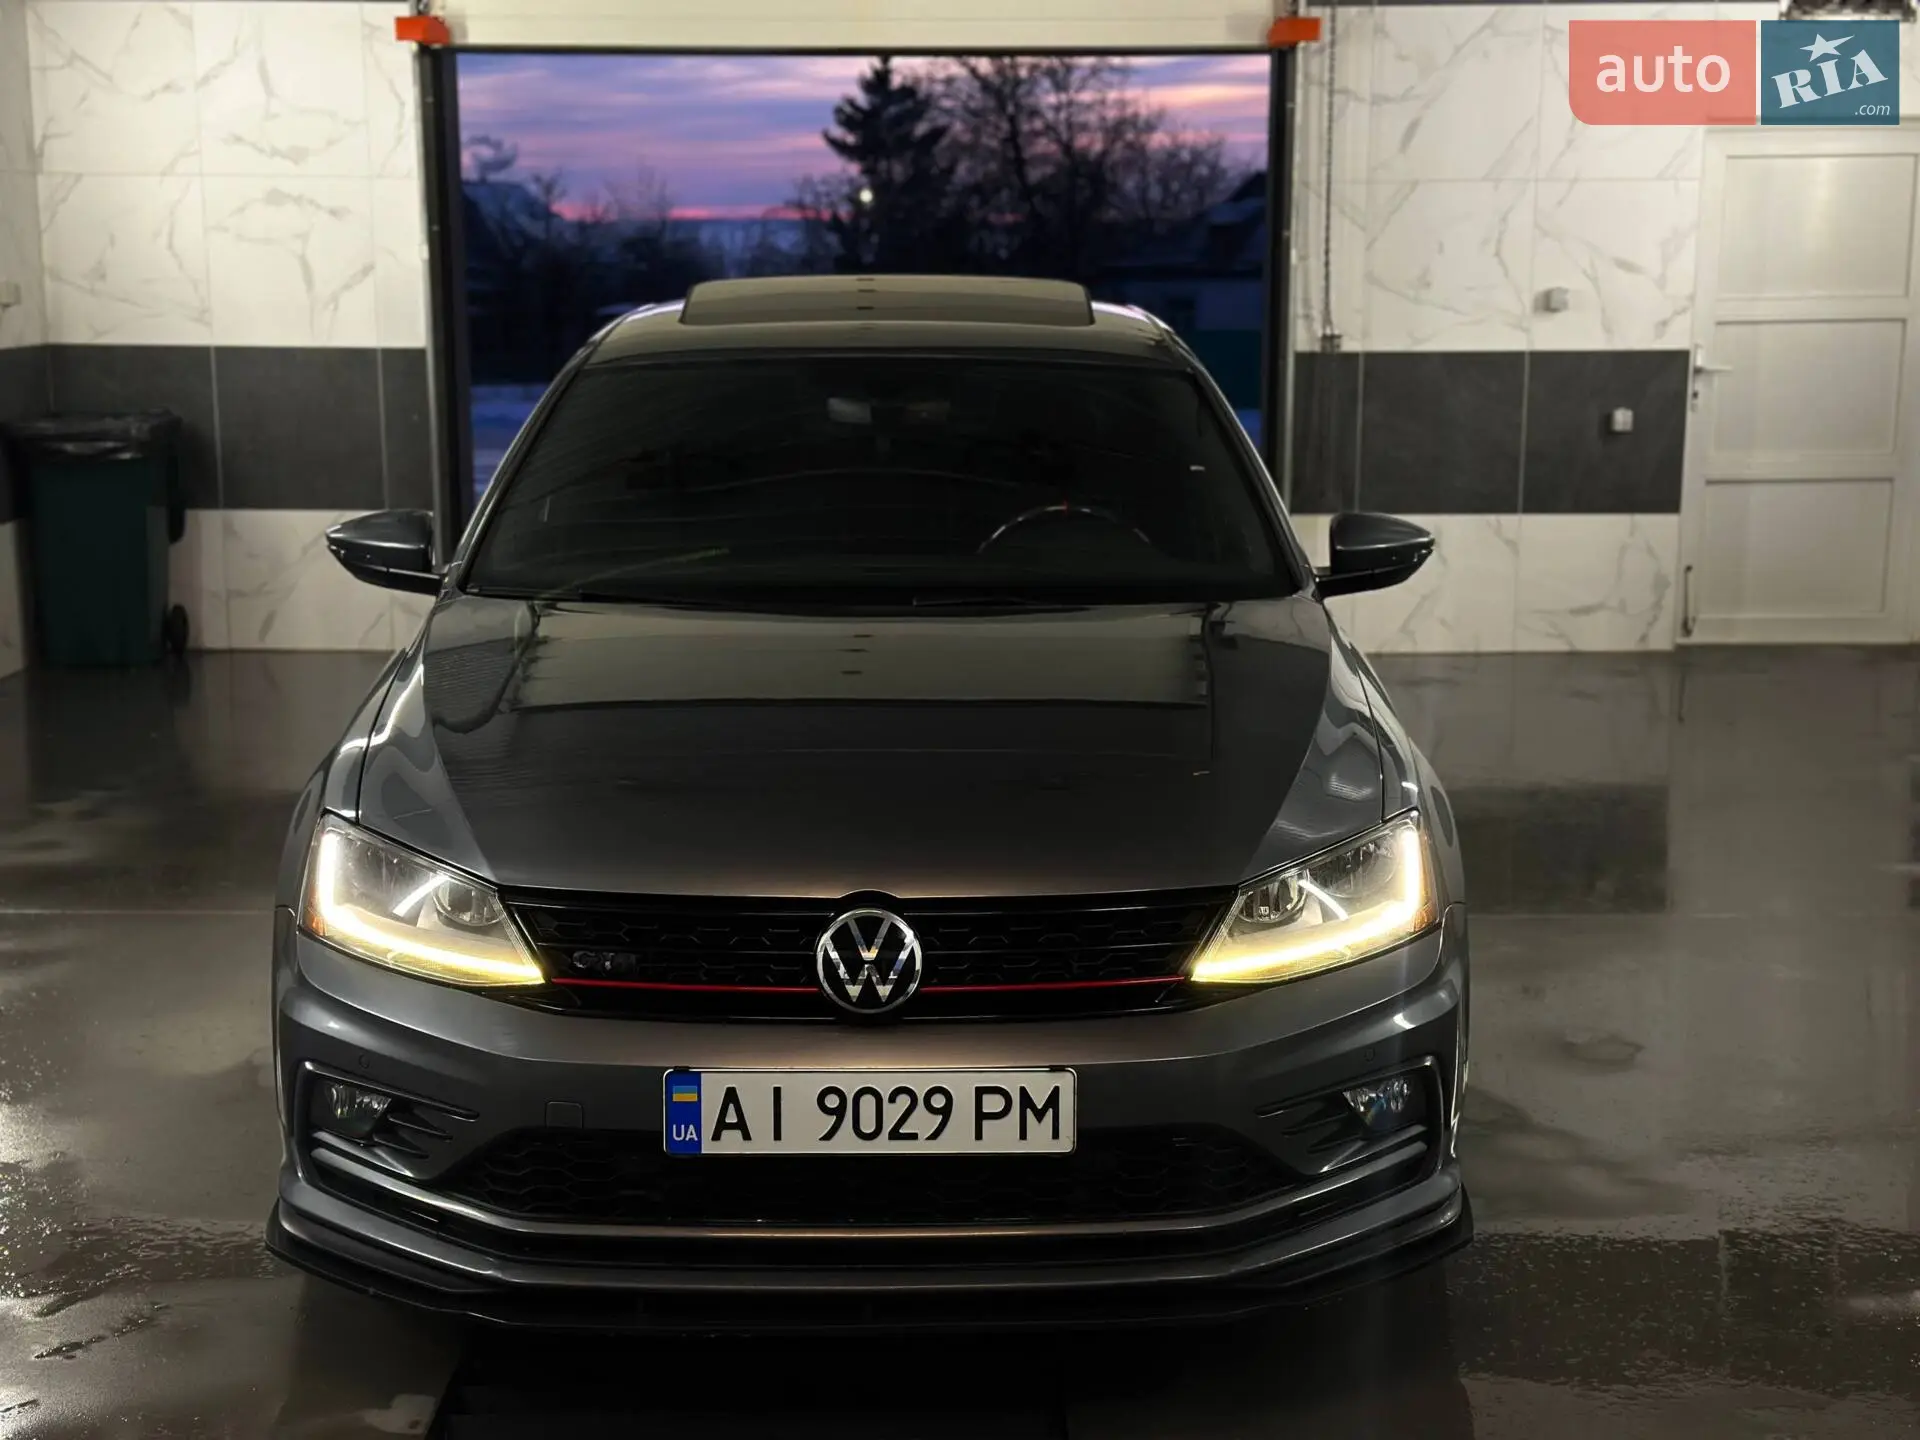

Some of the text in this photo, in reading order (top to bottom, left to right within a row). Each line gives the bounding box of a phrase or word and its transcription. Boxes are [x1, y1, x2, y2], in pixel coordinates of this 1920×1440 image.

[710, 1085, 1060, 1142] AI 9029 PM
[672, 1124, 698, 1141] UA
